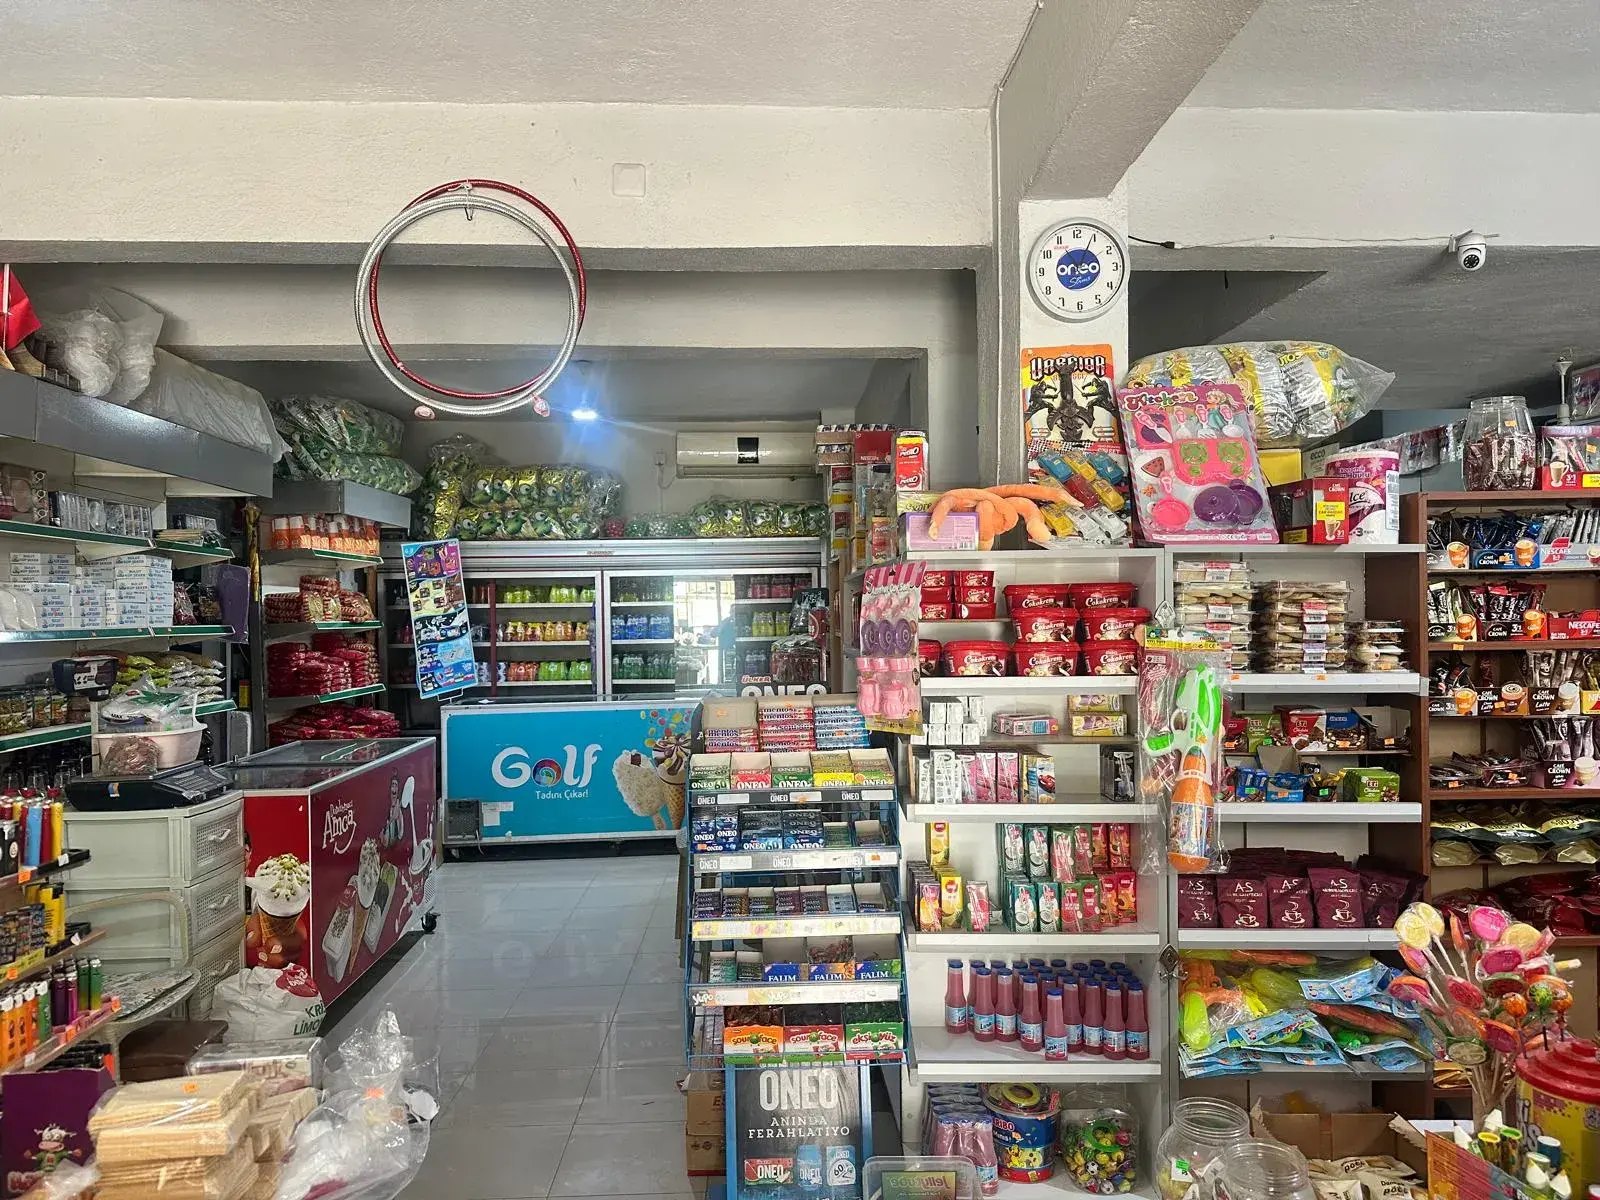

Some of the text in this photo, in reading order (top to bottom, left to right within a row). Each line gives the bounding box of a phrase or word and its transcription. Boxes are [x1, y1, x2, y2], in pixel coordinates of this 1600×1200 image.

[1073, 230, 1082, 239] 12
[1093, 233, 1097, 242] 1
[1057, 236, 1062, 245] 11
[1043, 250, 1052, 259] 10
[1106, 246, 1112, 255] 2
[1056, 262, 1100, 276] oneo
[1112, 262, 1119, 272] 3
[1039, 268, 1045, 277] 9
[1045, 286, 1052, 295] 8
[1107, 282, 1113, 290] 4
[1059, 297, 1065, 307] 7
[1095, 295, 1101, 305] 5
[1077, 301, 1083, 311] 6
[491, 743, 603, 789] Golf
[564, 789, 589, 801] Çıkar!
[770, 794, 788, 802] ONEO
[841, 792, 860, 800] ONEO
[814, 973, 843, 981] FALIM
[860, 971, 889, 979] FALIM
[759, 1070, 838, 1111] ONEO
[748, 1126, 850, 1139] FERAHLATIYO
[757, 1164, 784, 1179] ONEO
